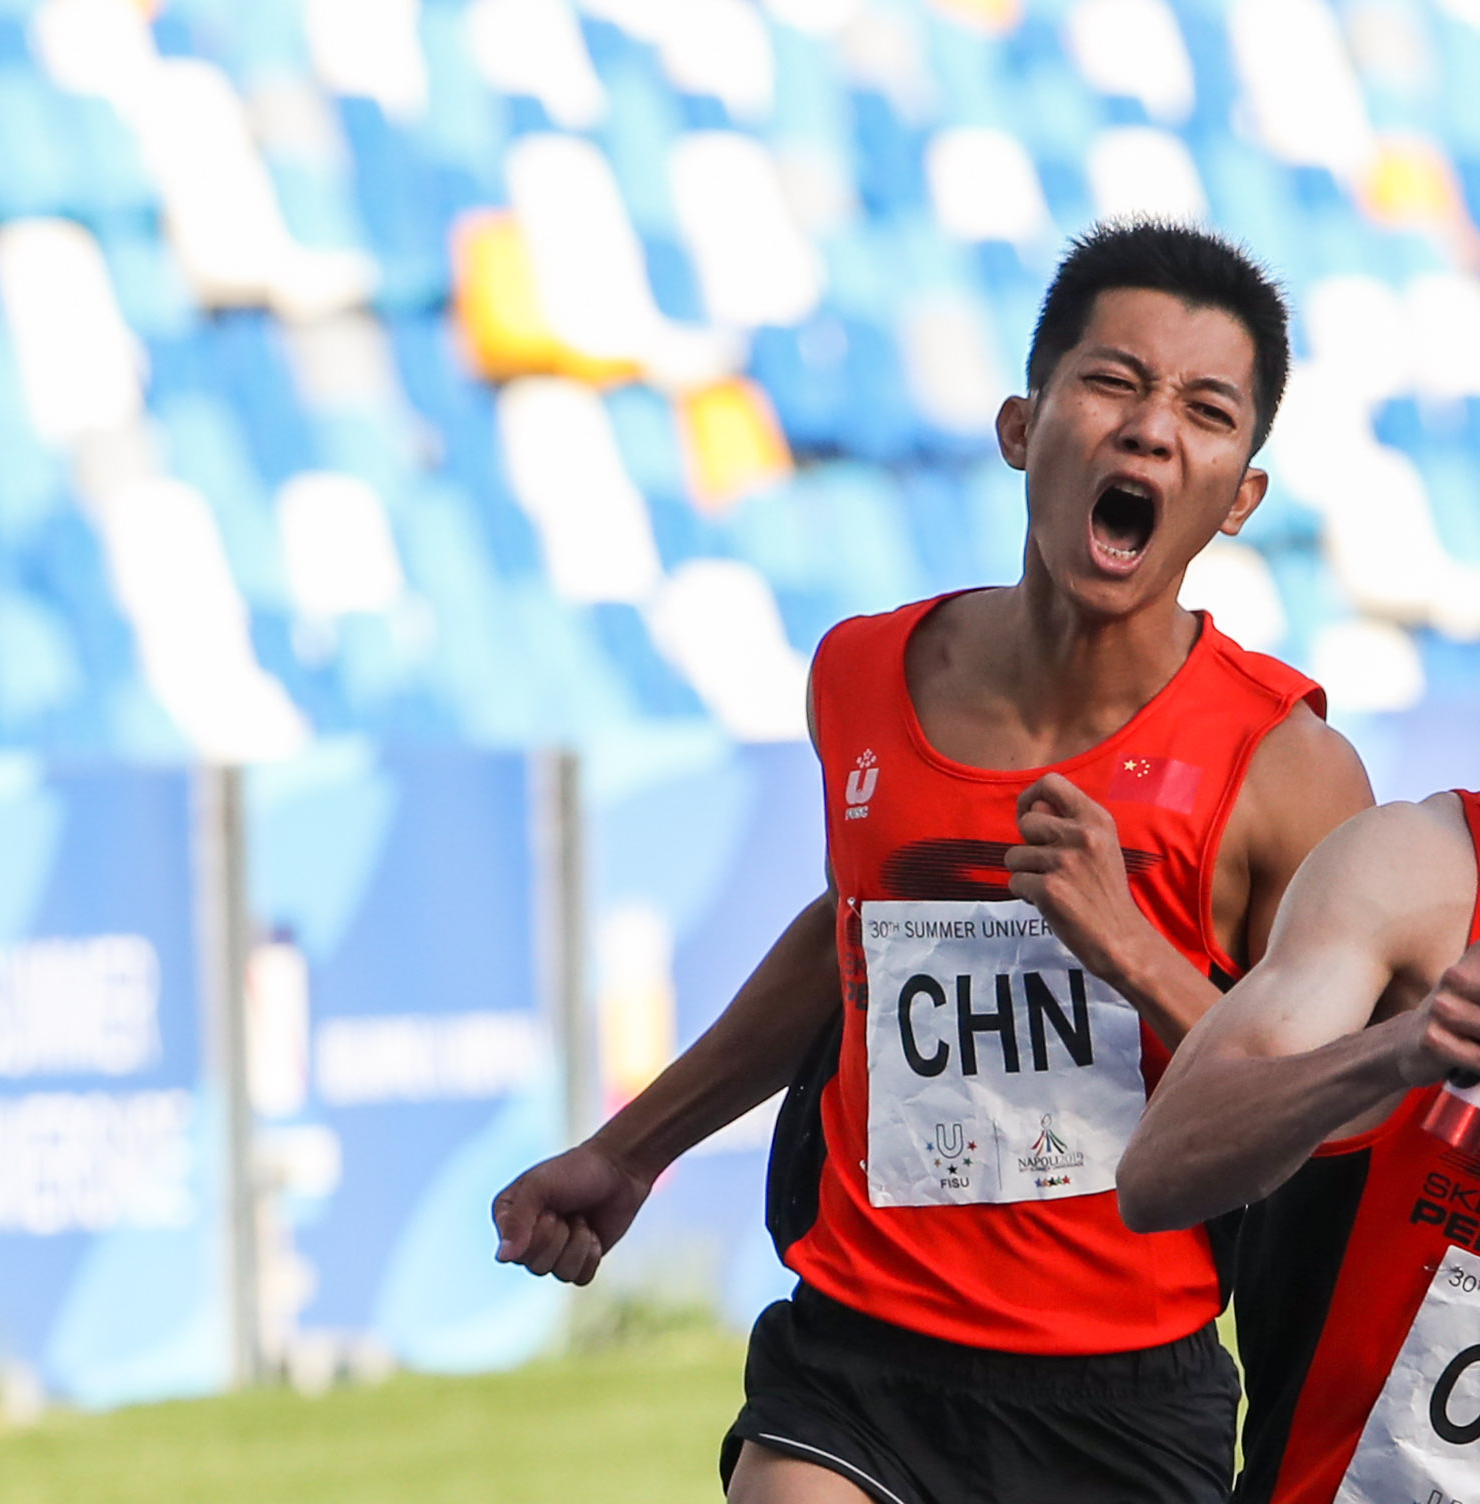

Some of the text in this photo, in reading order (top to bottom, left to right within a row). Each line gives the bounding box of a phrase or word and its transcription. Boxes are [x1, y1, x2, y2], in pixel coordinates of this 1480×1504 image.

[871, 918, 1054, 939] 30TH SUMMER UNIVER
[897, 968, 1095, 1078] CHN
[940, 1177, 969, 1188] FISU
